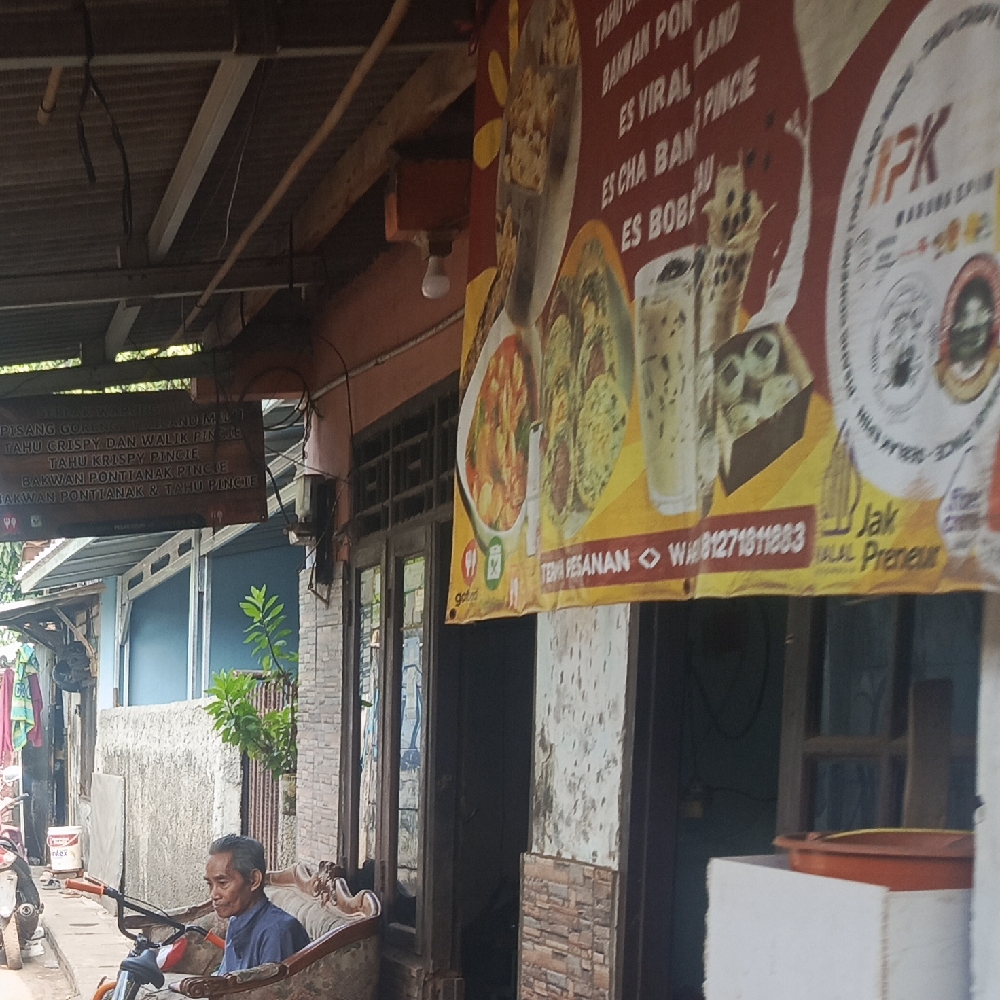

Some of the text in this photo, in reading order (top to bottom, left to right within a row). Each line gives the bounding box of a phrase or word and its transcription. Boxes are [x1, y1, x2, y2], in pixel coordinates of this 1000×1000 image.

[655, 0, 694, 50] PON
[618, 96, 635, 140] ES
[638, 62, 691, 123] VIRAL
[601, 170, 616, 211] ES
[617, 148, 647, 197] CHA
[621, 212, 642, 254] ES
[0, 423, 55, 438] PISANG
[4, 440, 42, 455] TAHU
[48, 437, 101, 453] CRISPY
[106, 434, 136, 450] DAN
[141, 431, 188, 447] WALIK
[48, 448, 199, 470] TAHU KRISPY PINCIE
[21, 461, 229, 488] BAKWAN PONTIANAK PINCIE
[60, 485, 145, 503] PONTIANAK
[149, 484, 159, 497] &
[164, 480, 203, 496] TAHU
[208, 475, 258, 491] PINCIE
[856, 501, 899, 539] Jak
[566, 549, 630, 578] PESANAN
